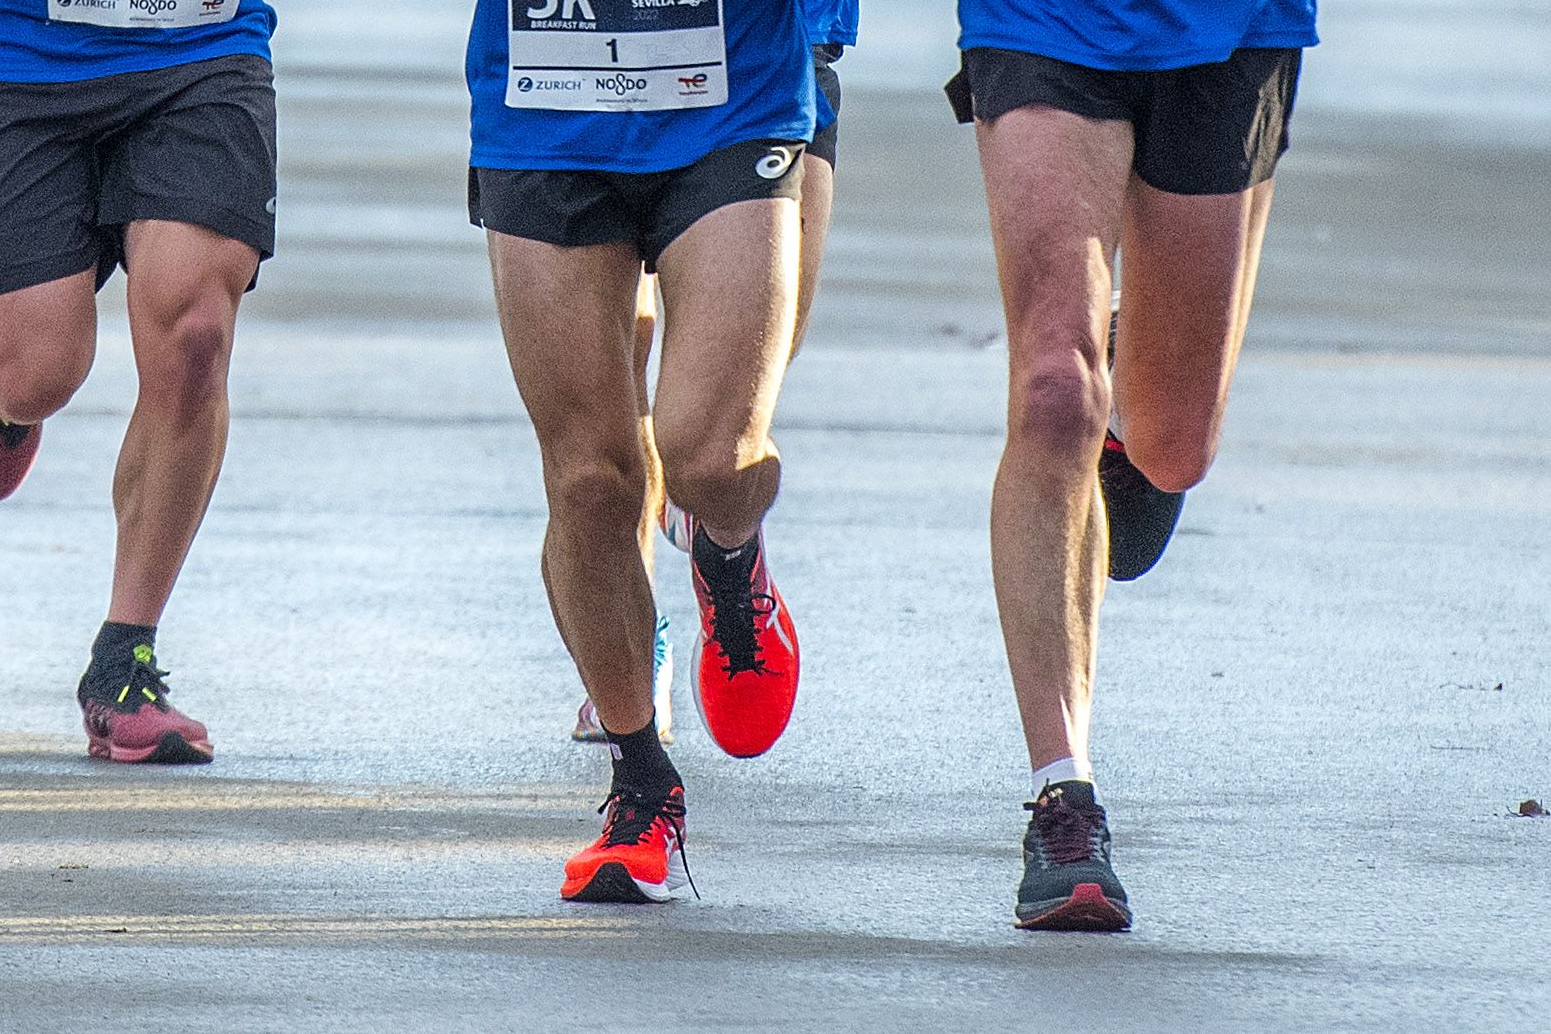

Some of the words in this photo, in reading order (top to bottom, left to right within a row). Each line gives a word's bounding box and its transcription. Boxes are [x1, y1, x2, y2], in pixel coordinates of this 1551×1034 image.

[531, 20, 577, 29] BREAKFAST
[578, 21, 597, 30] RUN
[606, 38, 619, 63] 1
[536, 81, 581, 91] ZURICH
